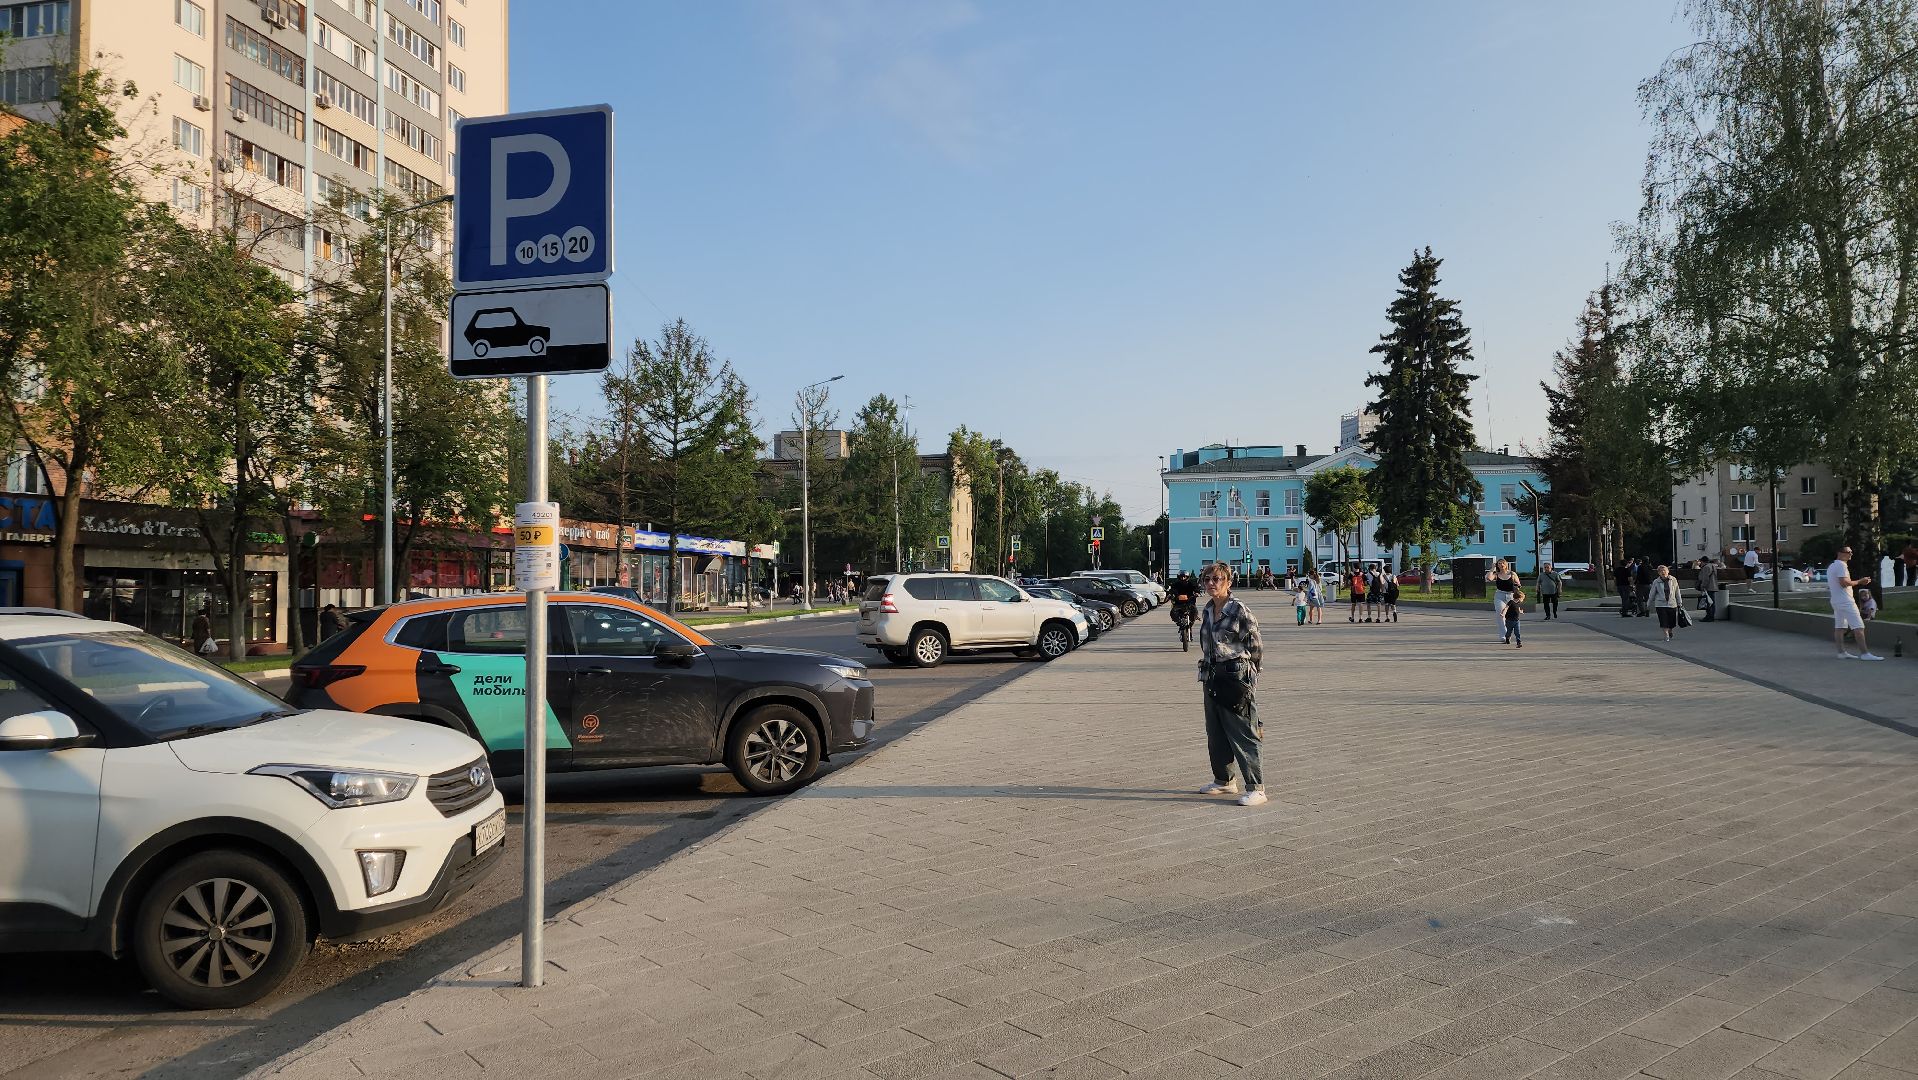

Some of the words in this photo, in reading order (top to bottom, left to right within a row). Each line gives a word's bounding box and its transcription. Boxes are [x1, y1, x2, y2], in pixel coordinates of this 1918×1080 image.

[490, 133, 571, 266] P
[520, 246, 534, 259] 10
[542, 242, 559, 257] 15
[568, 235, 589, 255] 20
[6, 532, 56, 543] ГАЛЕРЕ
[520, 530, 532, 541] 50
[473, 675, 513, 686] дели
